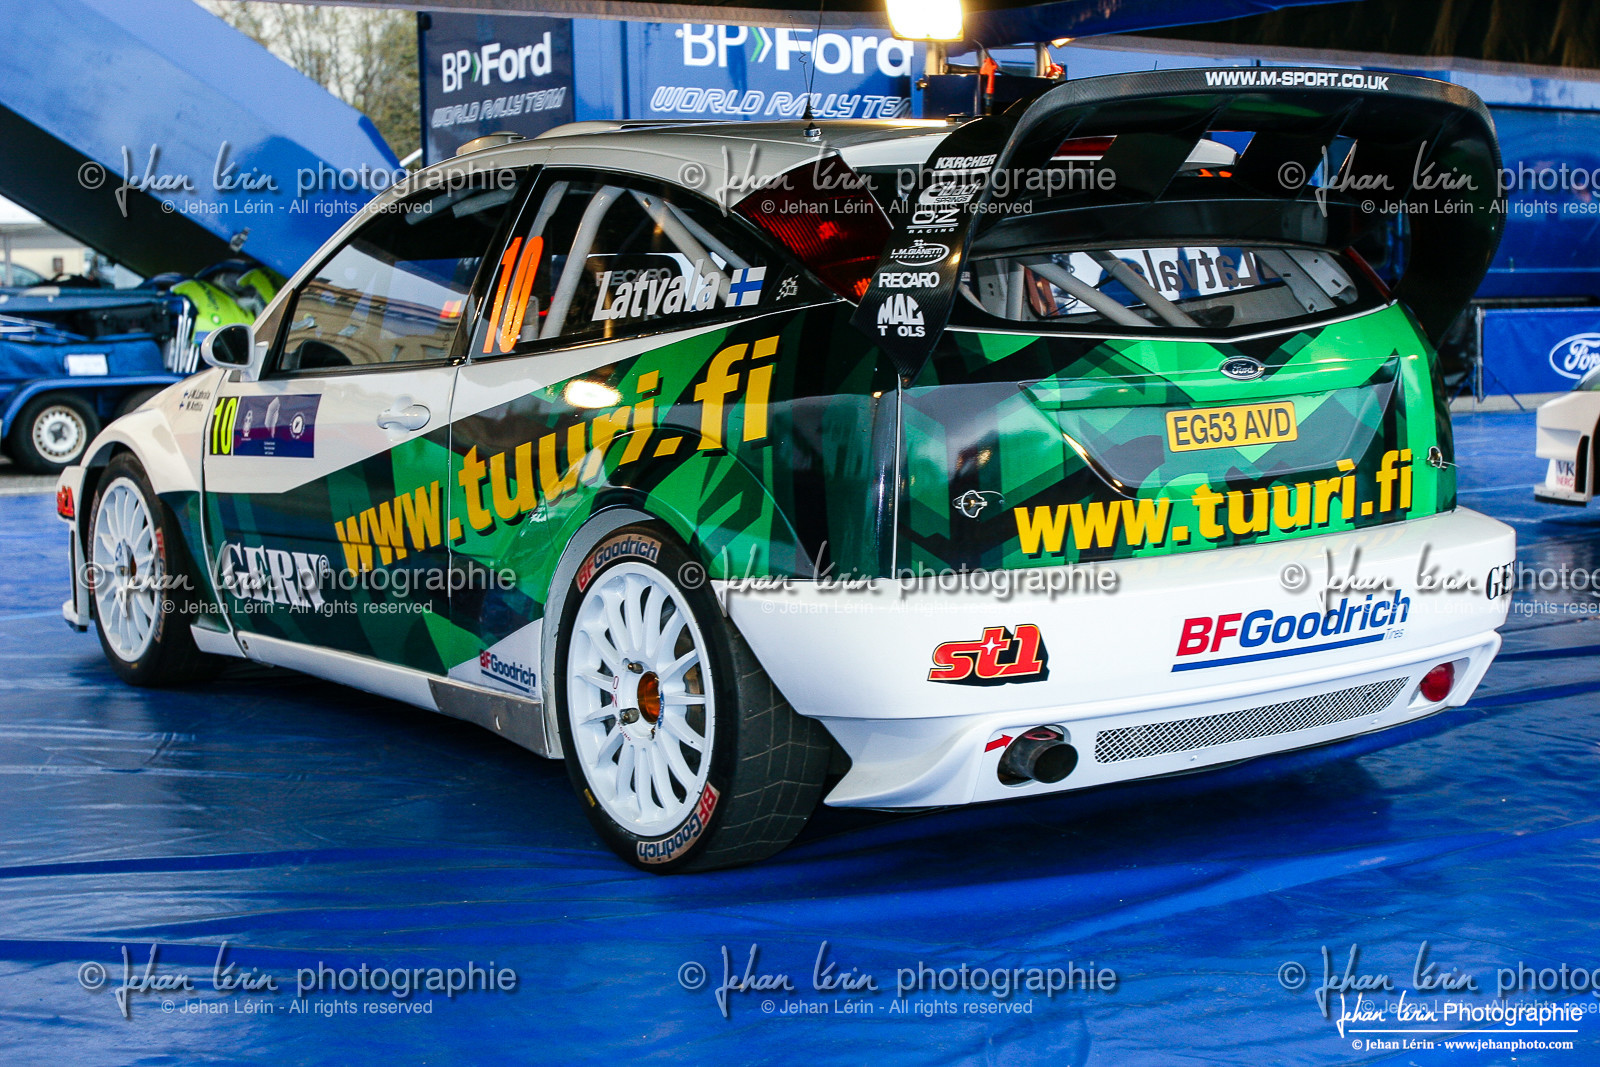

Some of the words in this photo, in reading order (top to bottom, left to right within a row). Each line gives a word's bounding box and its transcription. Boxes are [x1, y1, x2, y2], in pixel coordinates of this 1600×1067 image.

[442, 50, 471, 93] BP
[481, 31, 552, 86] Ford
[683, 23, 749, 68] BP
[775, 27, 915, 77] Ford
[431, 101, 479, 129] WORLD
[479, 93, 523, 121] RALLY
[524, 86, 567, 114] TEAM
[650, 86, 765, 115] WORLD
[764, 91, 860, 118] RALLY
[860, 95, 913, 119] TEA
[1205, 71, 1389, 91] WWW.M-SPORT.CO.UK
[482, 236, 544, 354] 10
[591, 259, 721, 321] Latvala
[878, 271, 940, 288] RECARO
[877, 293, 925, 325] MAC
[1232, 362, 1254, 374] Ford
[213, 397, 237, 455] 10
[1173, 411, 1237, 446] EG53
[1244, 407, 1291, 440] AVD
[334, 335, 780, 580] www.tuuri.fi
[1013, 448, 1412, 556] www.tuuri.fi
[578, 536, 659, 591] BFGoodrich
[1176, 589, 1410, 658] BFGoodrich
[480, 650, 536, 687] BFGoodrich
[927, 623, 1047, 685] st1
[638, 789, 717, 861] BFGoodrich
